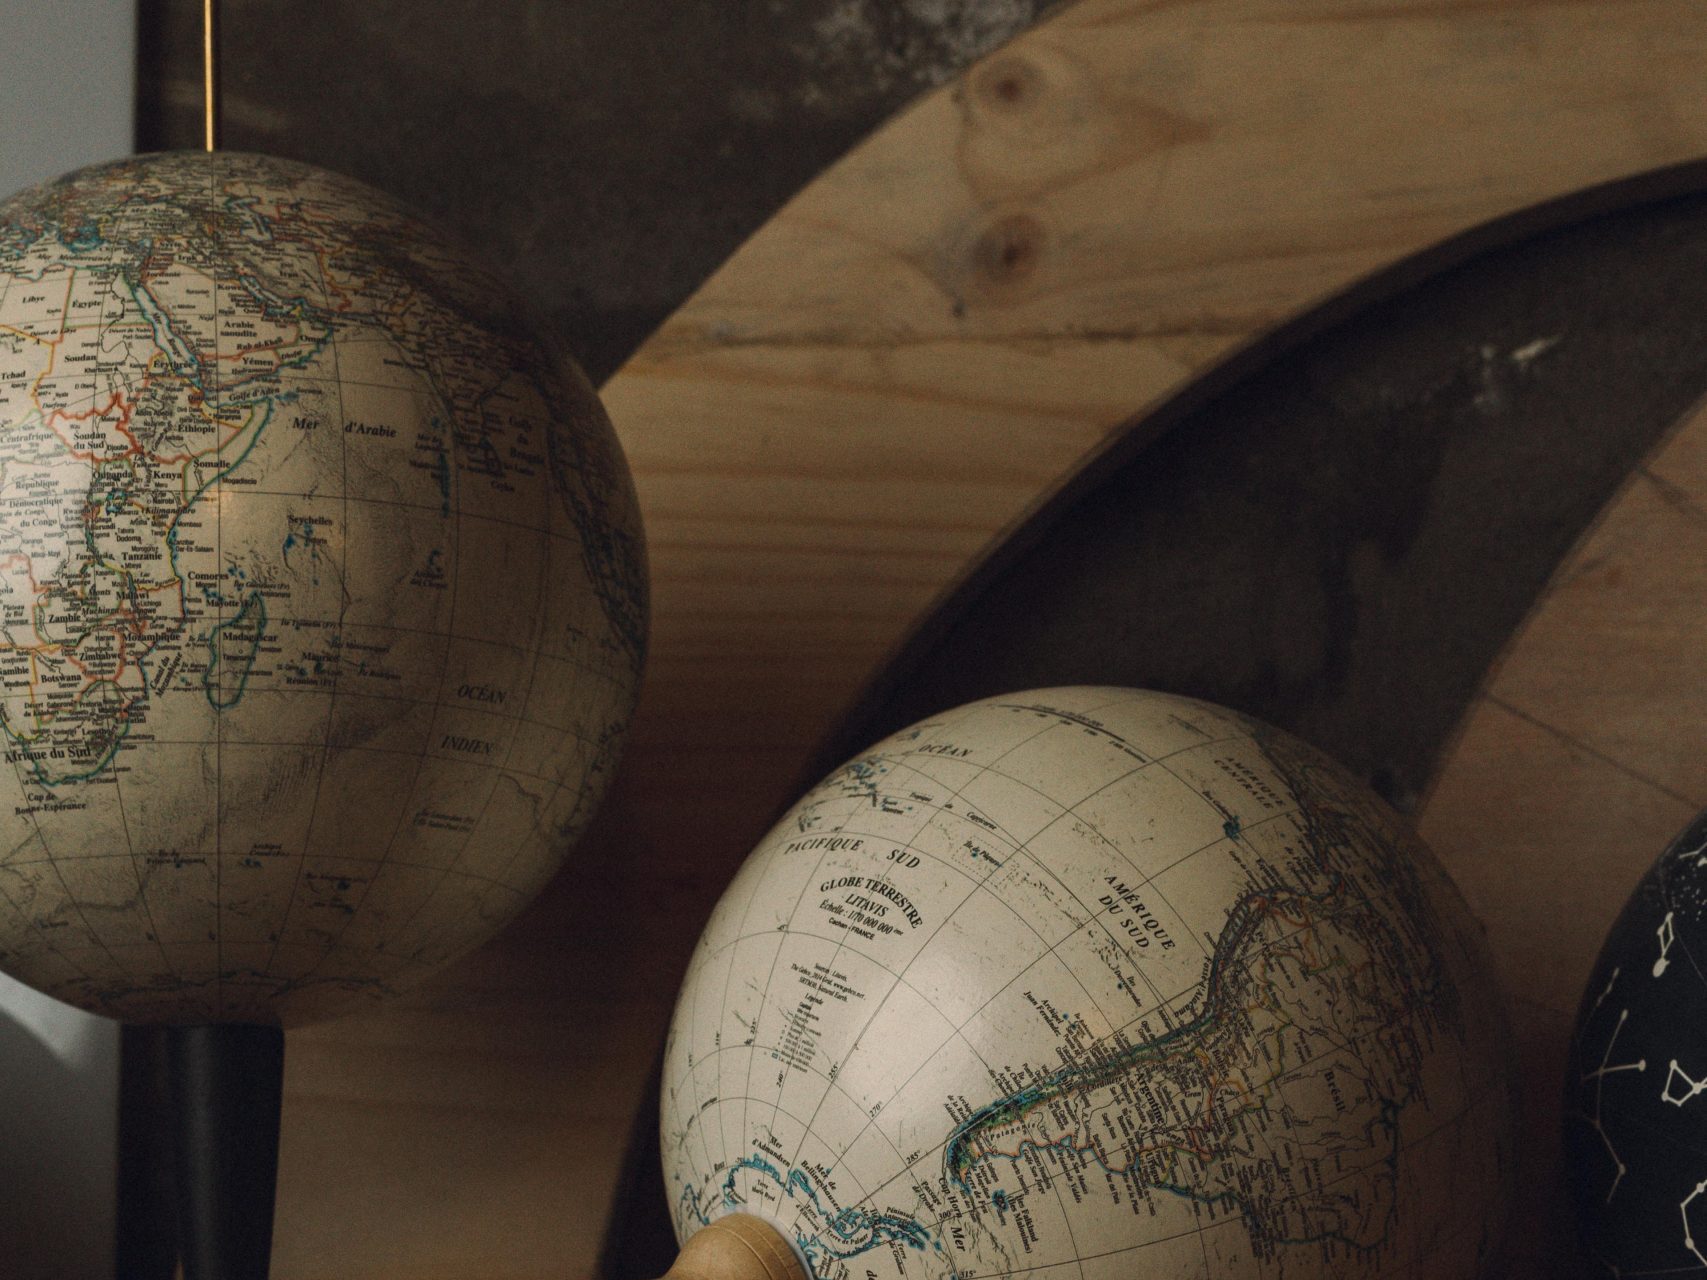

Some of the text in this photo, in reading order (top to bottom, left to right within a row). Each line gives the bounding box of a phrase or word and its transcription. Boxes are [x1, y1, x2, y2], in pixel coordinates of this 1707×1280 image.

[22, 294, 46, 304] Libye
[72, 299, 102, 309] Égypte
[224, 320, 255, 329] Arabie
[220, 329, 258, 338] saoudite
[64, 353, 97, 364] Soudan
[242, 355, 274, 367] Yémen
[1, 370, 27, 380] Tchad
[177, 423, 216, 433] Éthiopie
[292, 417, 397, 438] Mer d'Arabie
[73, 431, 106, 441] Soudan
[73, 440, 105, 450] du Sud
[193, 460, 231, 469] Somalie
[153, 470, 183, 480] Kenya
[15, 480, 60, 490] République
[9, 497, 63, 508] Démocratique
[32, 518, 58, 528] Congo
[287, 514, 333, 526] Seychelles
[121, 551, 162, 561] Tanzanie
[187, 571, 229, 581] Comores
[206, 598, 240, 608] Mayotte
[49, 613, 82, 624] Zambie
[222, 631, 279, 642] Madagascar
[80, 651, 123, 662] Zimbabwe
[41, 673, 82, 684] Botswana
[456, 684, 507, 705] OCÉAN
[440, 734, 496, 756] INDIEN
[917, 742, 974, 758] OCÉAN
[5, 745, 92, 764] Afrique du Sud
[27, 792, 44, 803] Cap
[14, 801, 88, 816] Bonne-Espérance
[784, 837, 921, 870] PACIFIQUE SUD
[820, 876, 923, 929] GLOBE TERRESTRE
[845, 893, 889, 917] LITAVIS
[1103, 874, 1177, 951] AMÉRIQUE
[863, 916, 879, 929] 000
[876, 922, 894, 935] 000
[1097, 893, 1124, 915] DU
[1119, 917, 1151, 949] SUD
[850, 925, 876, 941] FRANCE
[1023, 990, 1039, 1006] Juan
[827, 1061, 839, 1080] 255°
[1323, 1069, 1347, 1113] Brésil
[1135, 1072, 1165, 1125] Argentine
[868, 1101, 883, 1118] 270°
[769, 1135, 783, 1149] Mer
[905, 1149, 921, 1165] 285°
[814, 1163, 829, 1179] Mer
[800, 1160, 841, 1213] Bellingshausen
[938, 1176, 963, 1219] Cap Horn
[938, 1208, 953, 1221] 300°
[950, 1226, 966, 1252] Mer
[960, 1269, 977, 1279] 315°
